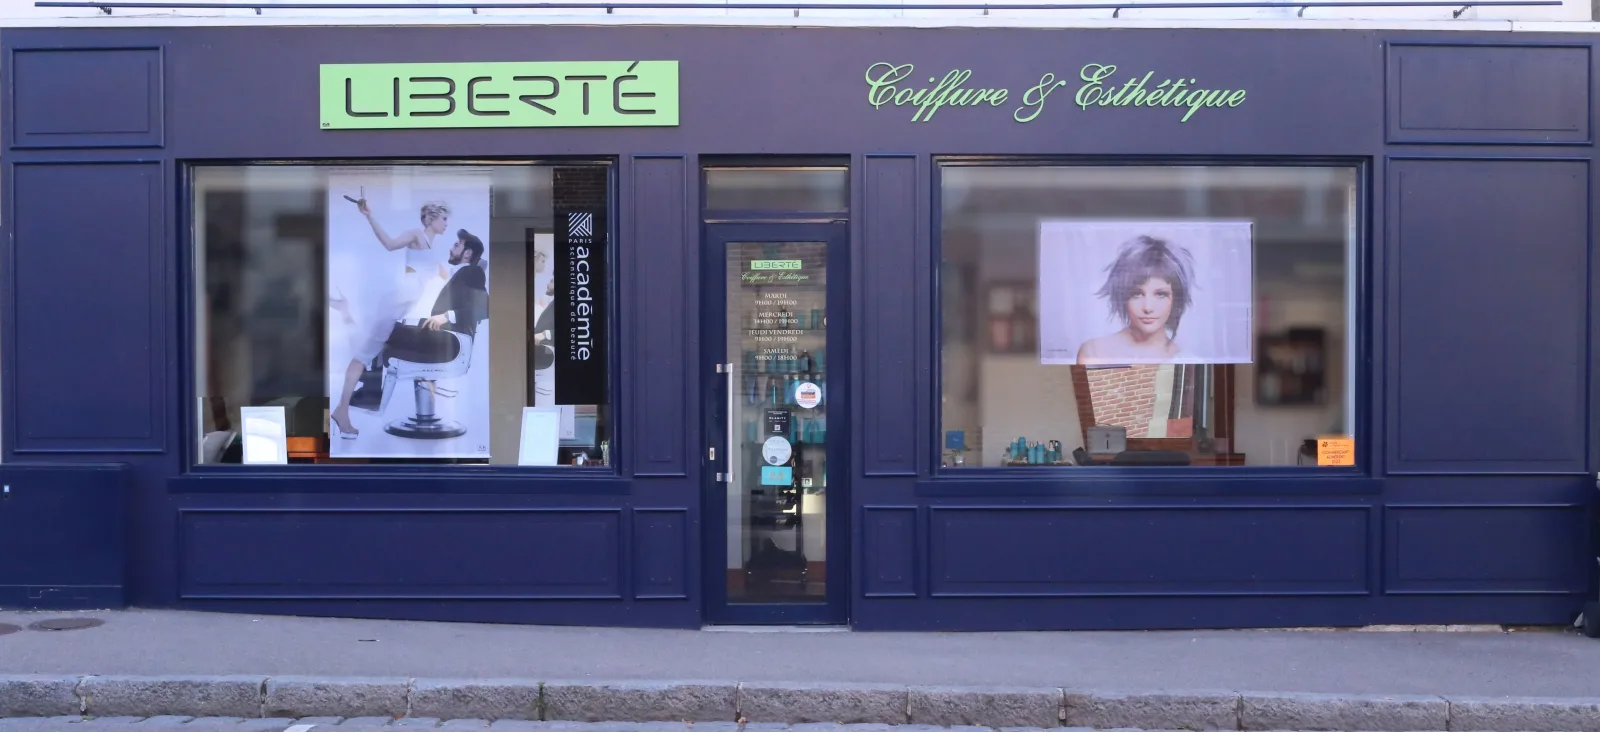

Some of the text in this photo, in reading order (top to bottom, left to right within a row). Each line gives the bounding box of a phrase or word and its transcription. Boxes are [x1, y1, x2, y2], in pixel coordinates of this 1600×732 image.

[345, 61, 657, 117] LIBERTÉ
[865, 62, 1247, 122] Coiffure & Esthétique
[754, 260, 799, 268] LIBERTÉ
[570, 311, 576, 322] de
